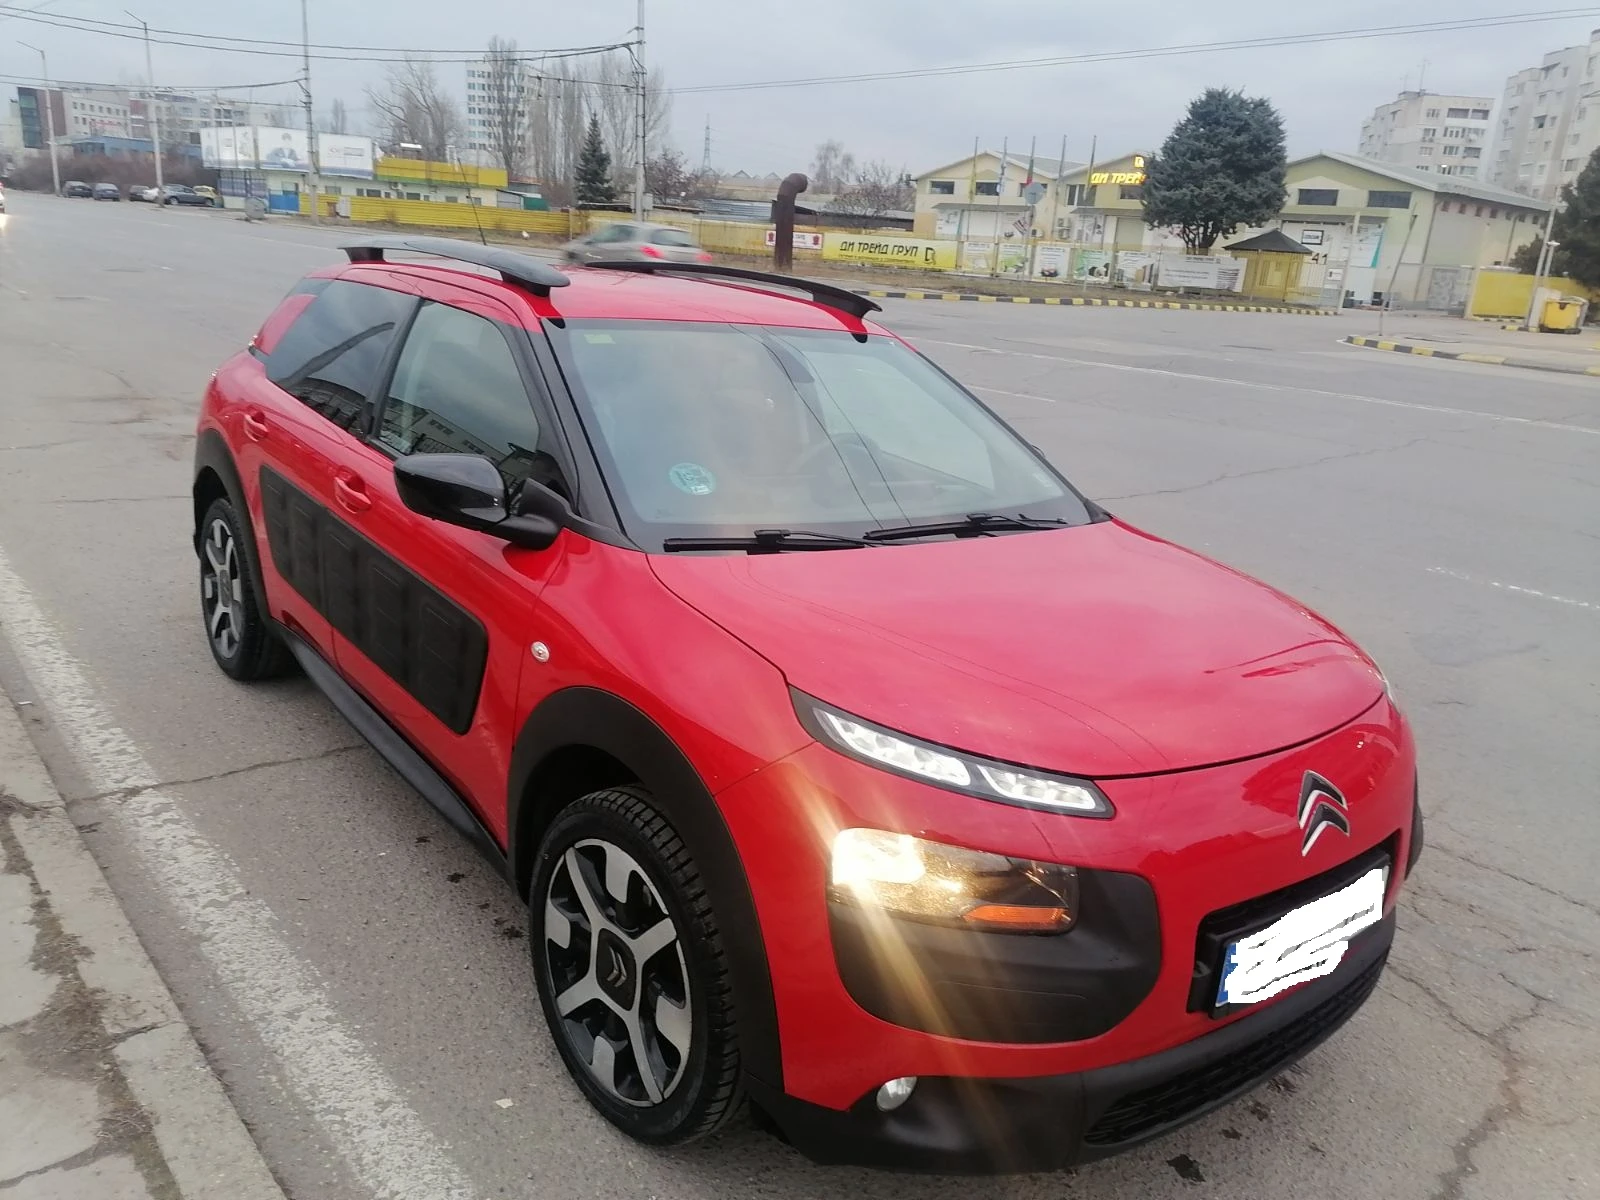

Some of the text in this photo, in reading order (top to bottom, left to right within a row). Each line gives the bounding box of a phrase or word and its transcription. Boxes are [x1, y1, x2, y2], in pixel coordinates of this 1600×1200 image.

[1091, 172, 1109, 184] ДИ
[839, 240, 919, 257] ДИ ТРЕЙД ГРУП
[1311, 252, 1328, 266] 41
